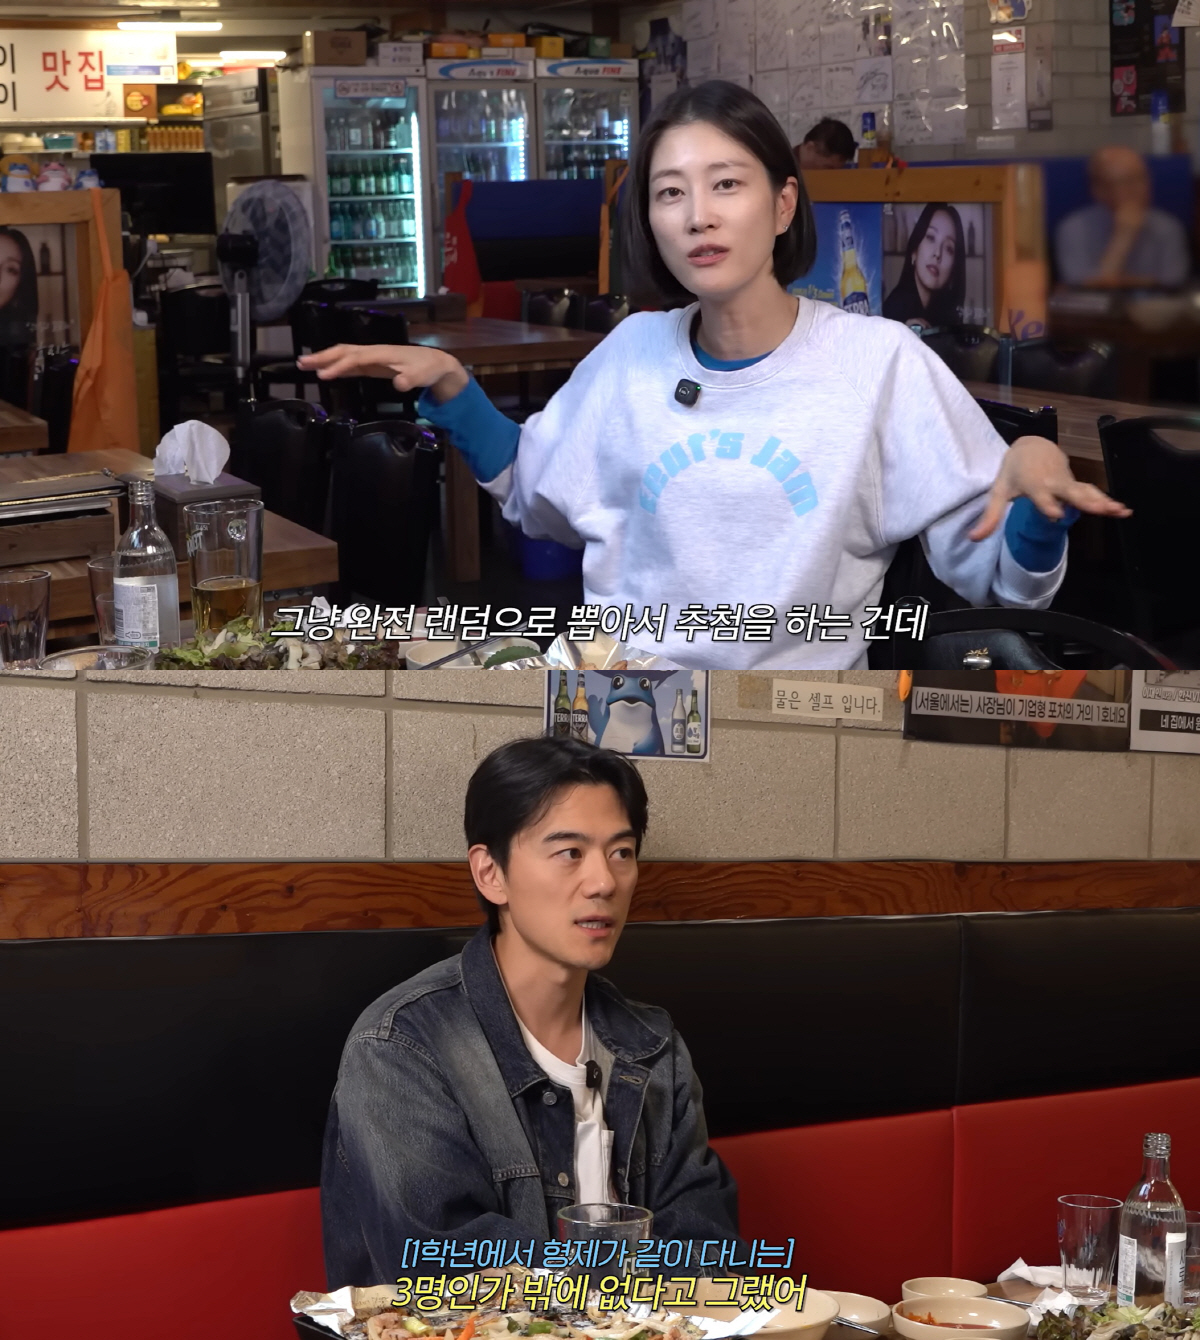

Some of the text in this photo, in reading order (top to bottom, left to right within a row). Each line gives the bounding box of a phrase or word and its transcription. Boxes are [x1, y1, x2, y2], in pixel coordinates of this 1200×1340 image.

[42, 50, 105, 92] 맛집
[750, 436, 819, 517] Jam
[774, 688, 881, 714] 물은 셀프 입니다.
[914, 688, 1127, 725] (서울에서는) 사장님이 기업형 포차의 거의 1호네요
[572, 713, 588, 723] TERRA
[1170, 715, 1195, 731] 집에서
